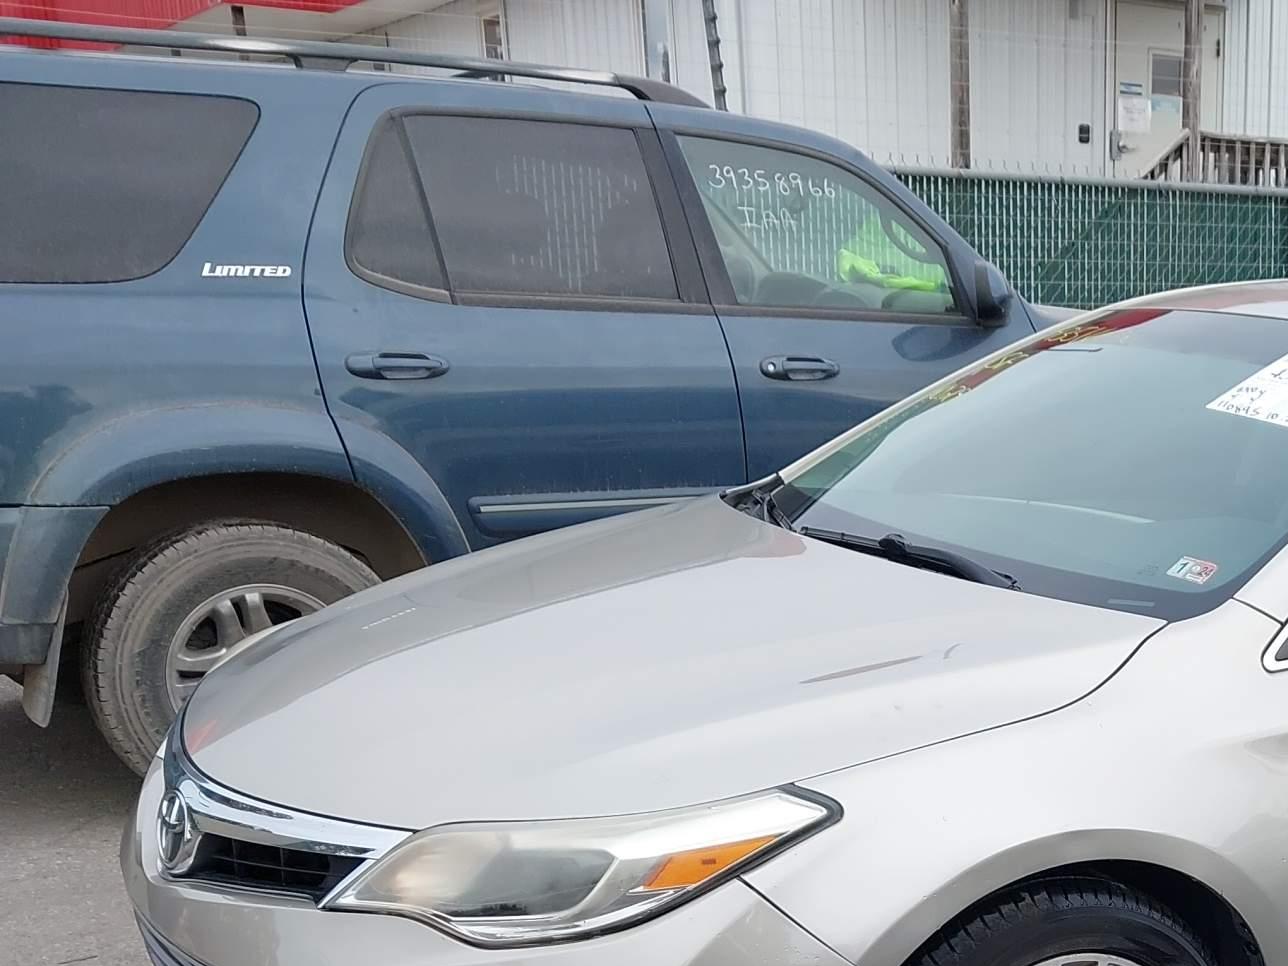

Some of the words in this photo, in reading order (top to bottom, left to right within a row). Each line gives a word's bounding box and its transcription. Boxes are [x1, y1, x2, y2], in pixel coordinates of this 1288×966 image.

[708, 164, 836, 198] 39358966
[737, 206, 798, 231] IAA
[201, 262, 292, 277] LIMITED
